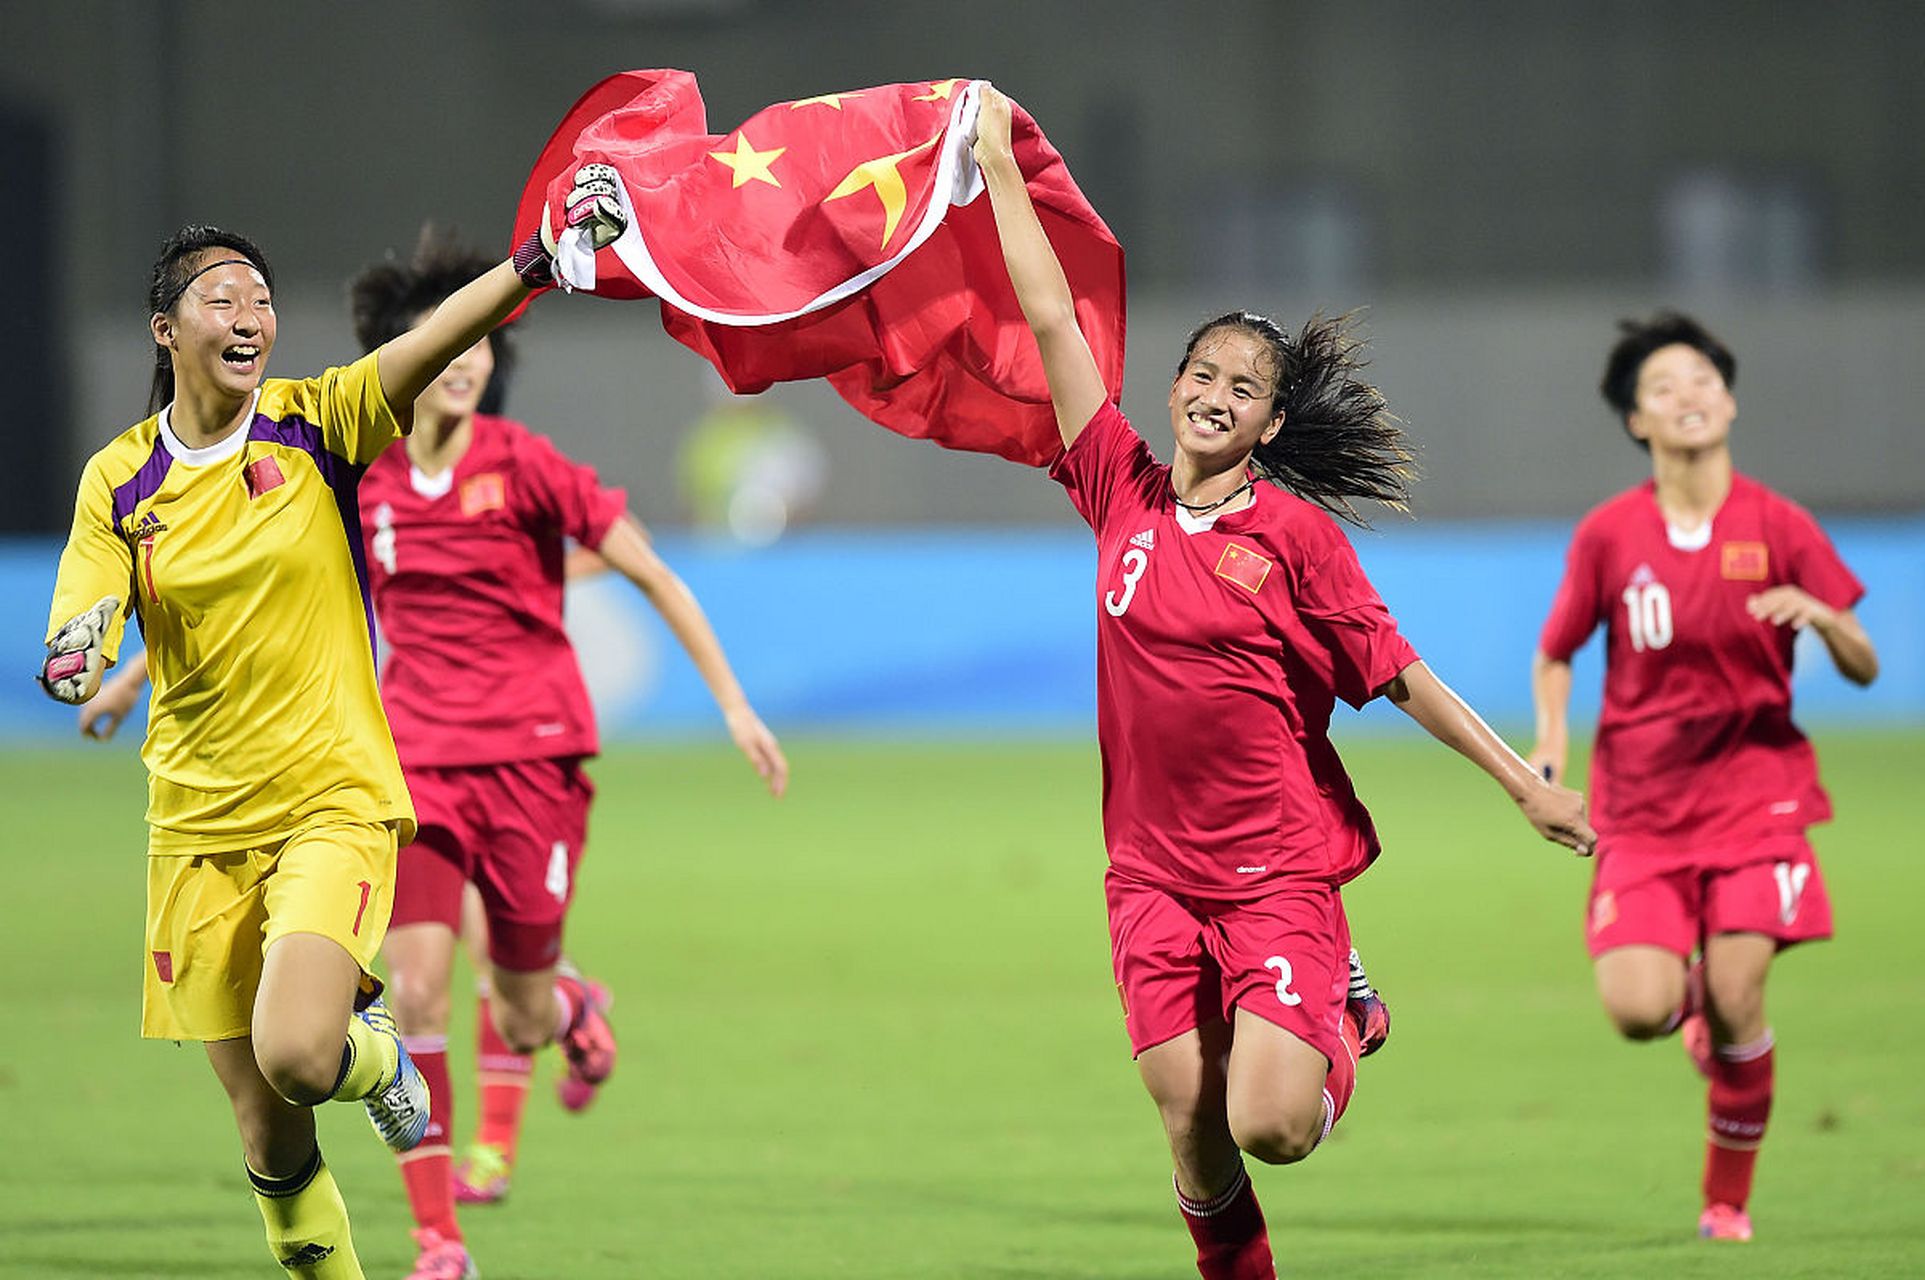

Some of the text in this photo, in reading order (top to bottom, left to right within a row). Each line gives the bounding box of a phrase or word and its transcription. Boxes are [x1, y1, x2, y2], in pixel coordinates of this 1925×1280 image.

[140, 535, 160, 604] 1
[372, 527, 397, 575] 4
[1105, 549, 1148, 616] 3
[1623, 585, 1673, 653] 10
[545, 841, 569, 904] 4
[352, 880, 371, 937] 1
